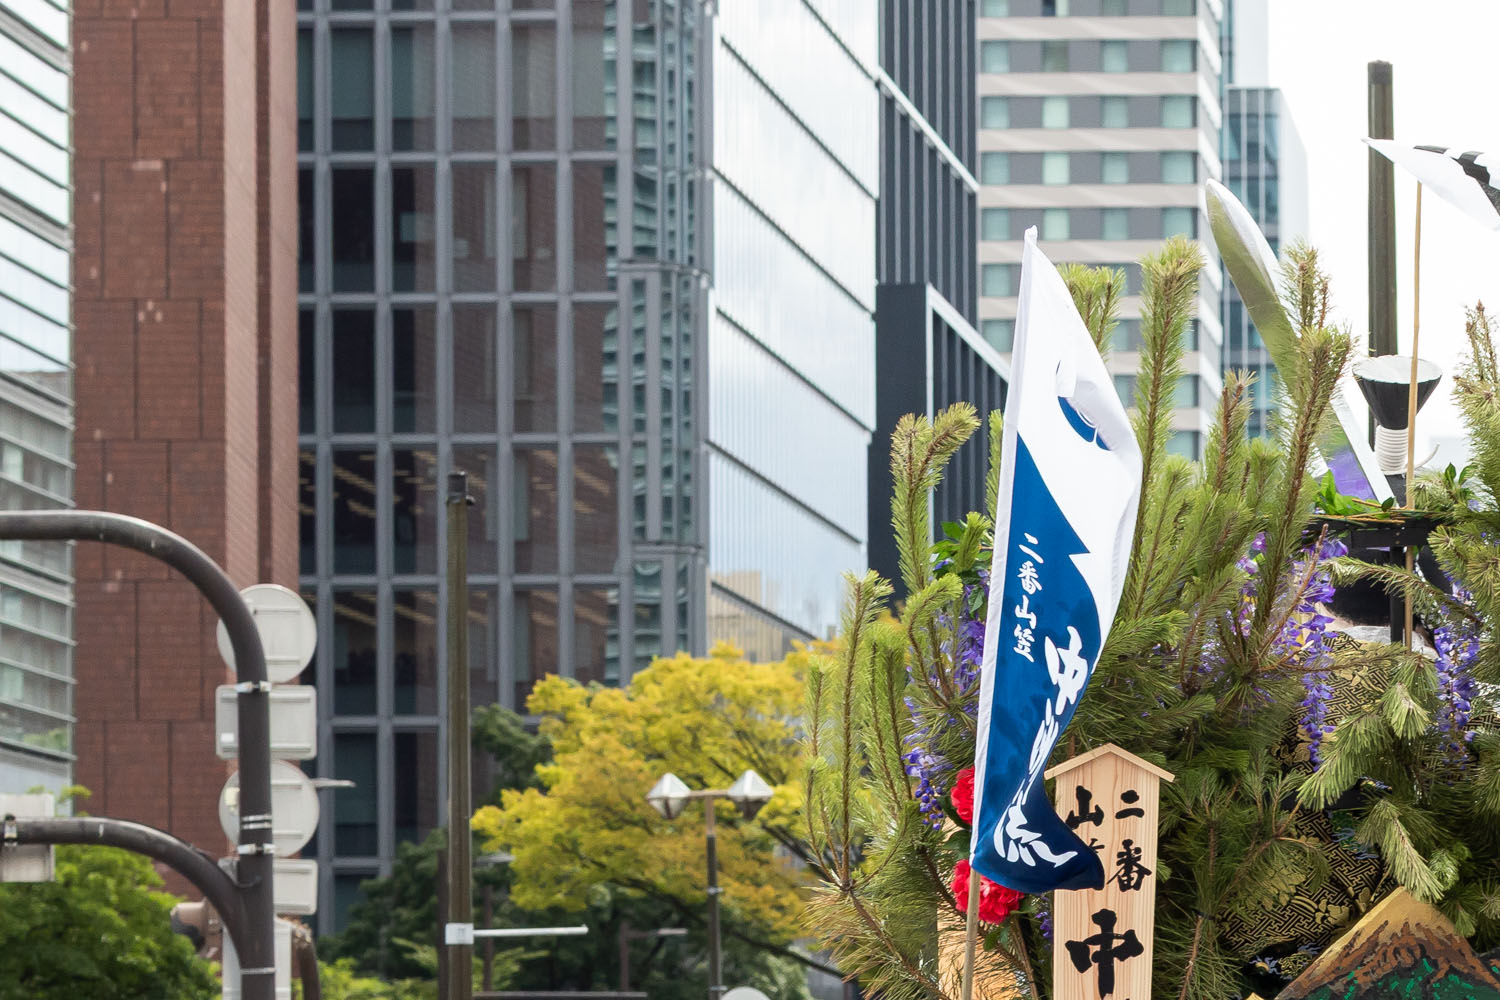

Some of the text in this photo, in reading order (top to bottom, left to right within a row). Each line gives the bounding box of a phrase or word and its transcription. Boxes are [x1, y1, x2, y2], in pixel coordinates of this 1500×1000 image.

[1013, 532, 1044, 663] 二番山笠
[1066, 785, 1106, 878] 山
[1107, 790, 1152, 893] 二番
